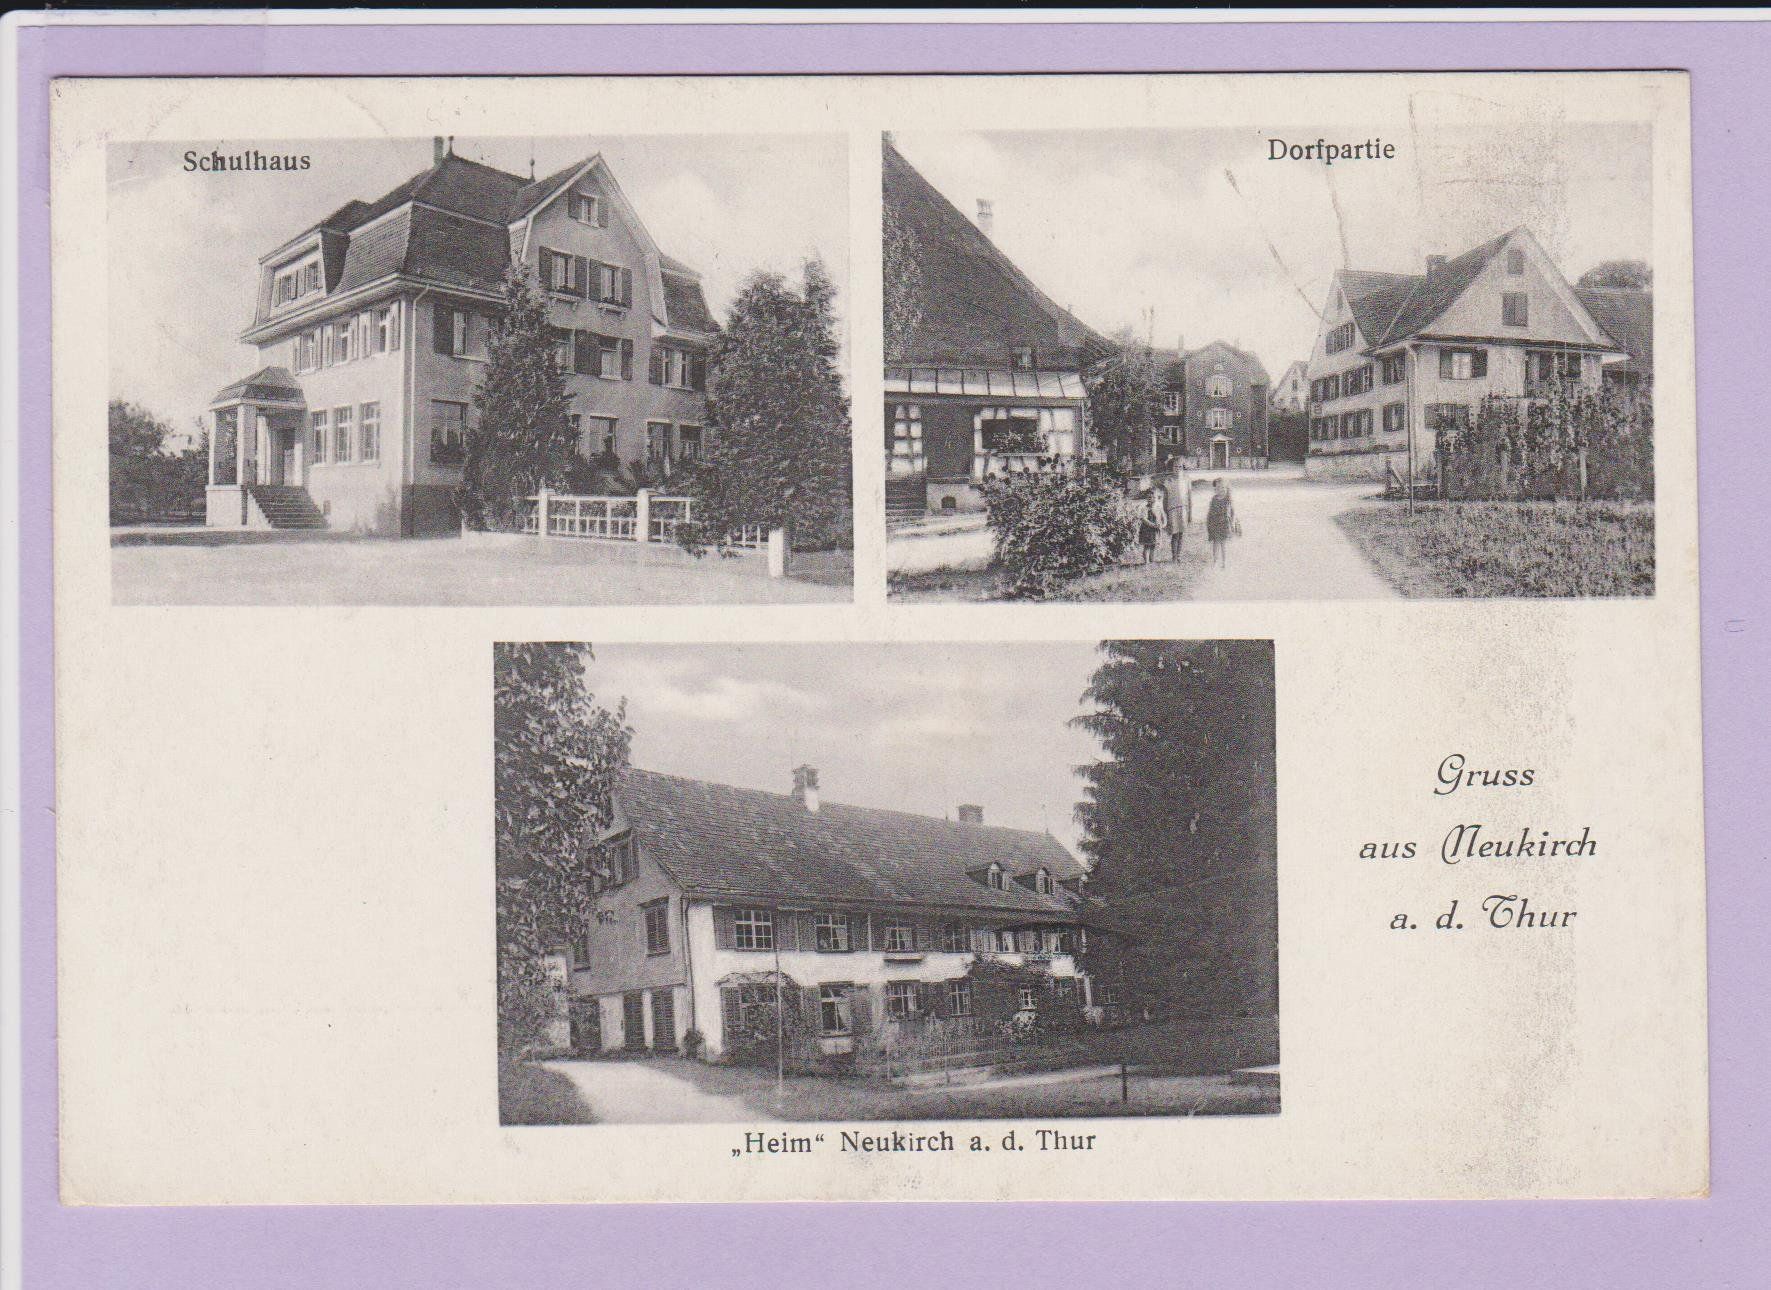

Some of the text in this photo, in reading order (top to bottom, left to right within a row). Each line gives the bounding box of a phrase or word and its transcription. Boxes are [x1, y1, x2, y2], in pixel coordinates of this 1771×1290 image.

[184, 150, 311, 172] Schulhaus
[1268, 138, 1395, 165] Dorfpartie
[1433, 753, 1535, 796] Gruss
[1360, 824, 1597, 865] aus Neukirch
[1390, 894, 1577, 930] a. d. Thur
[840, 1130, 954, 1153] Neukirch
[969, 1135, 990, 1152] a.
[1001, 1130, 1024, 1151] d.
[1035, 1129, 1097, 1151] Thur
